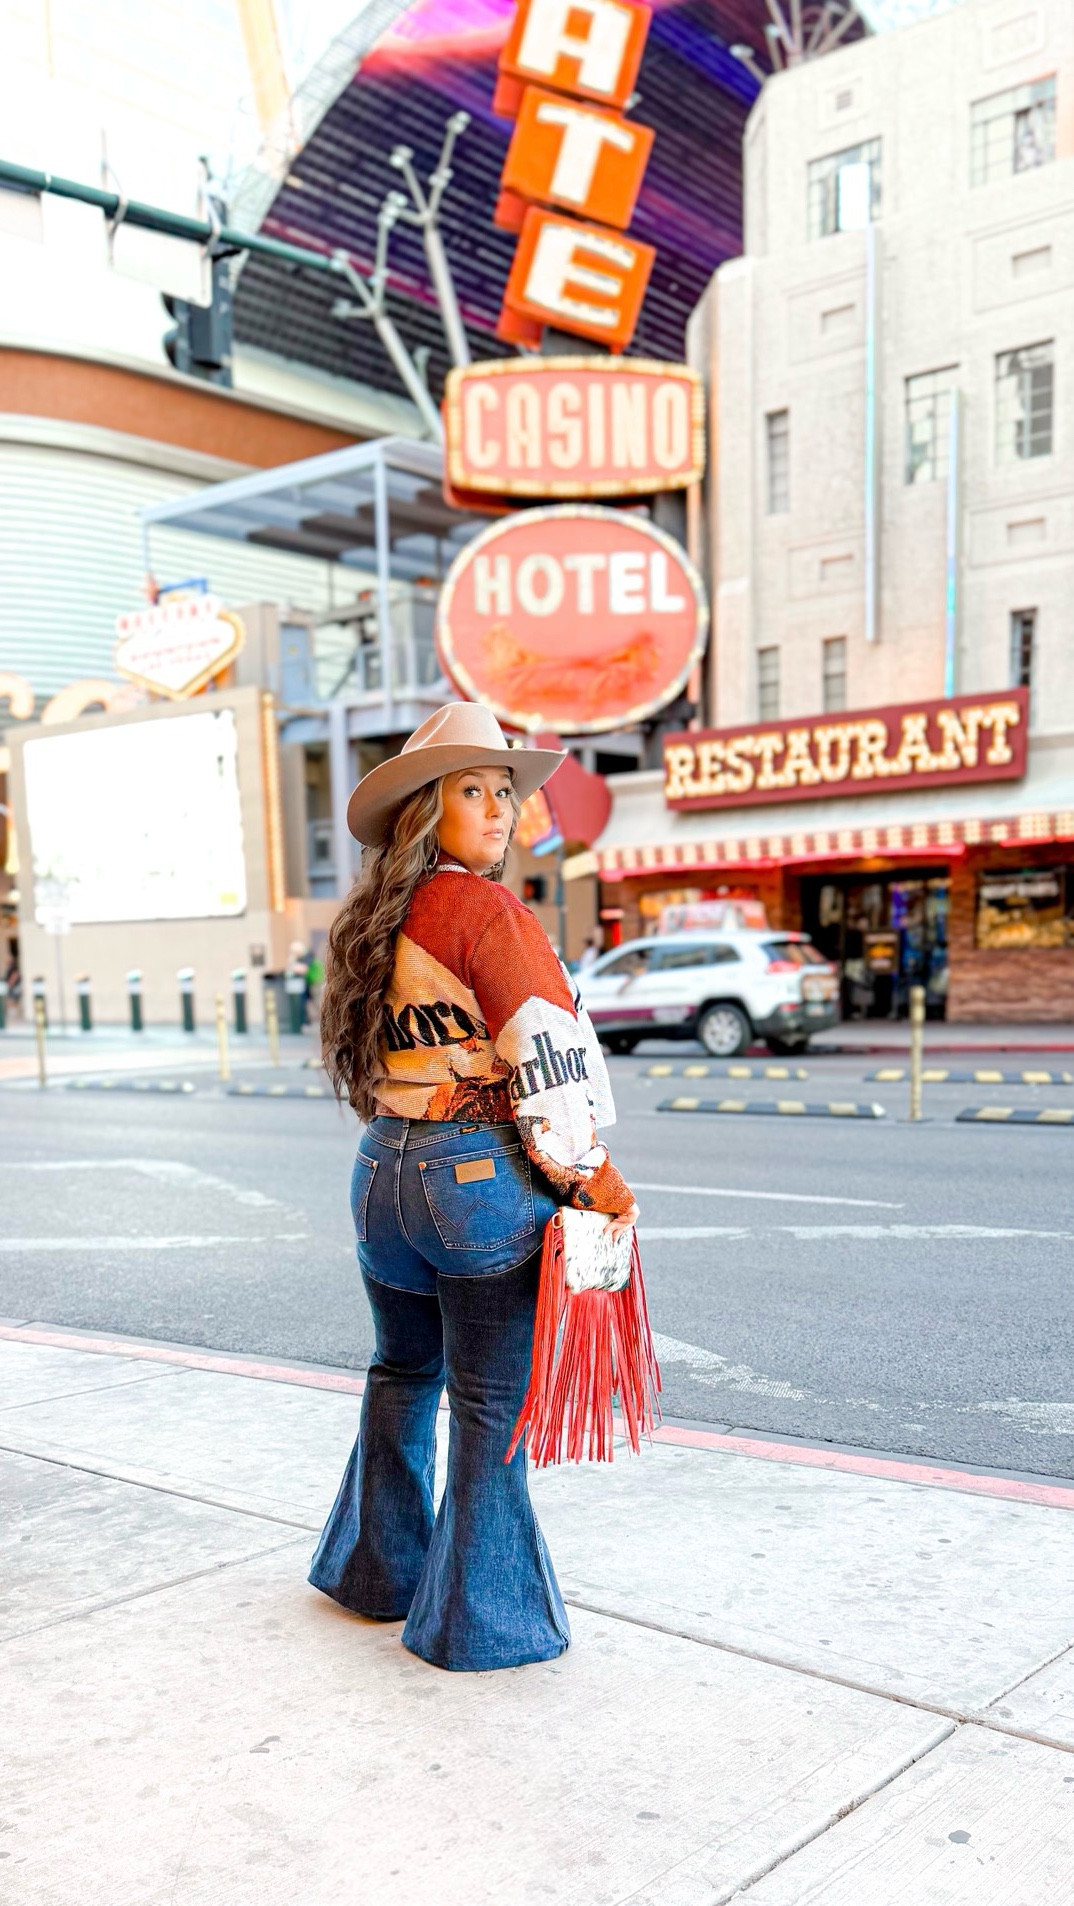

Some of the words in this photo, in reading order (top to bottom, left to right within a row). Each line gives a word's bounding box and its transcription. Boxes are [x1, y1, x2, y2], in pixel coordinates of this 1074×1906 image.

[465, 382, 688, 469] CASINO
[473, 552, 686, 617] HOTEL
[664, 700, 1021, 799] RESTAURANT
